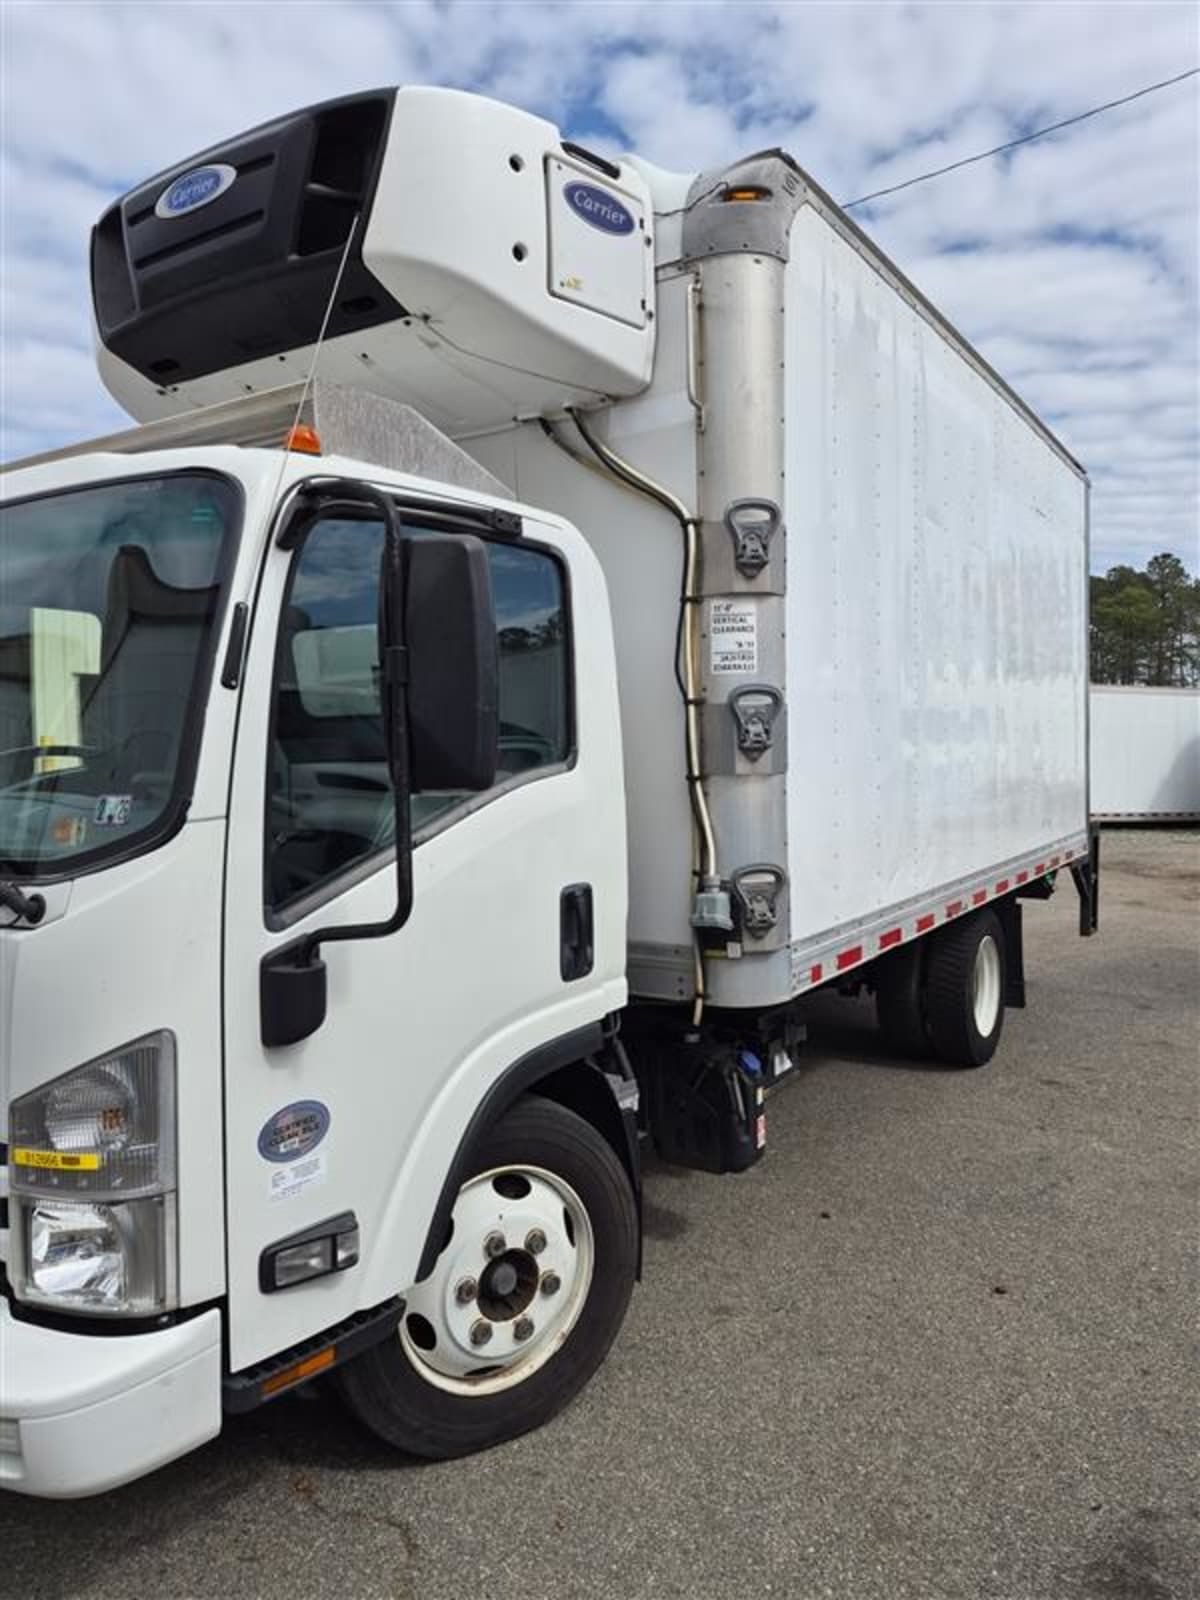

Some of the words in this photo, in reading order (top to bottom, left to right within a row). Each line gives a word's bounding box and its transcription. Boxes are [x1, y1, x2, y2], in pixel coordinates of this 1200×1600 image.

[573, 189, 627, 225] Carrier
[713, 617, 748, 625] VERTICAL
[713, 626, 755, 635] CLEARANCE
